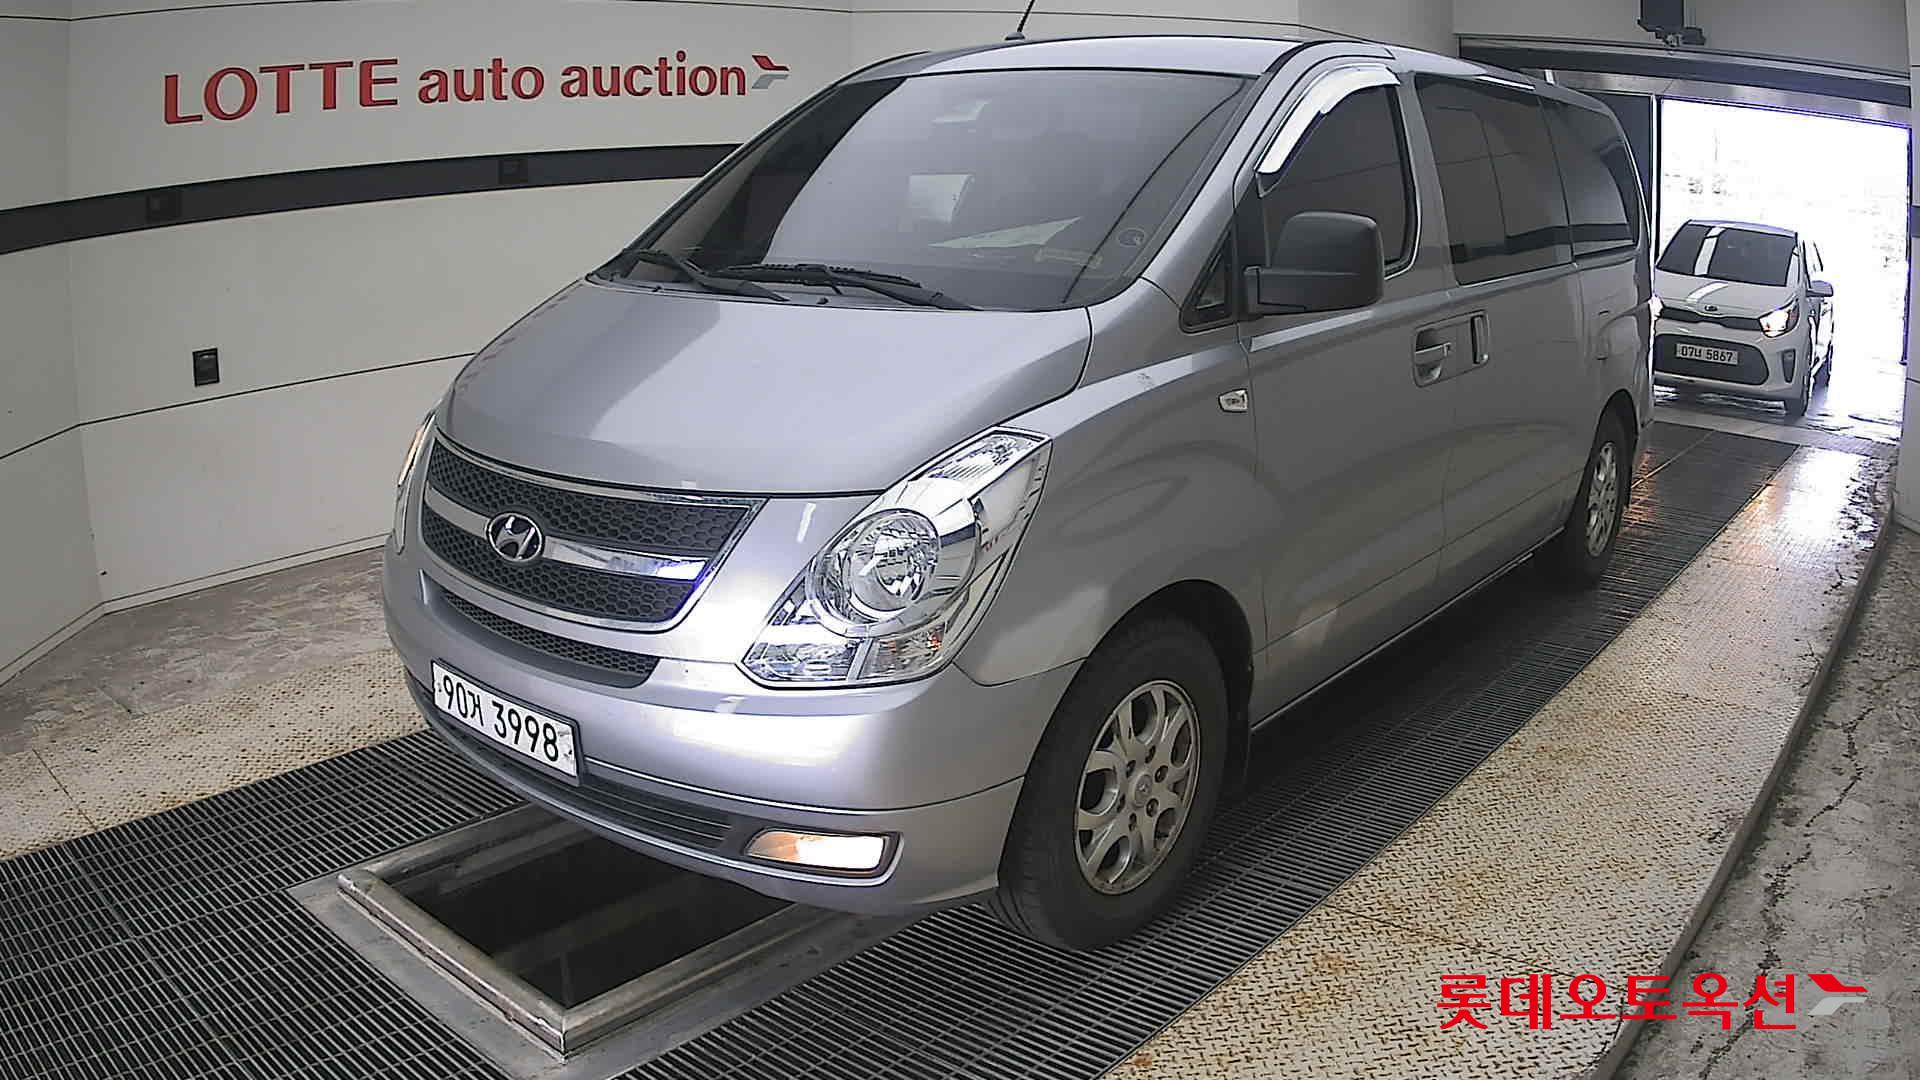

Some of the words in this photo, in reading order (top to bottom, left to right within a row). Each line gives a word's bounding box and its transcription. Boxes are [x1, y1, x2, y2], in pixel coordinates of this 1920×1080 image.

[163, 57, 399, 126] LOTTE
[417, 56, 546, 104] auto
[560, 50, 747, 98] auction
[1706, 348, 1734, 363] 5867
[443, 675, 485, 727] 90거
[491, 700, 559, 762] 3998
